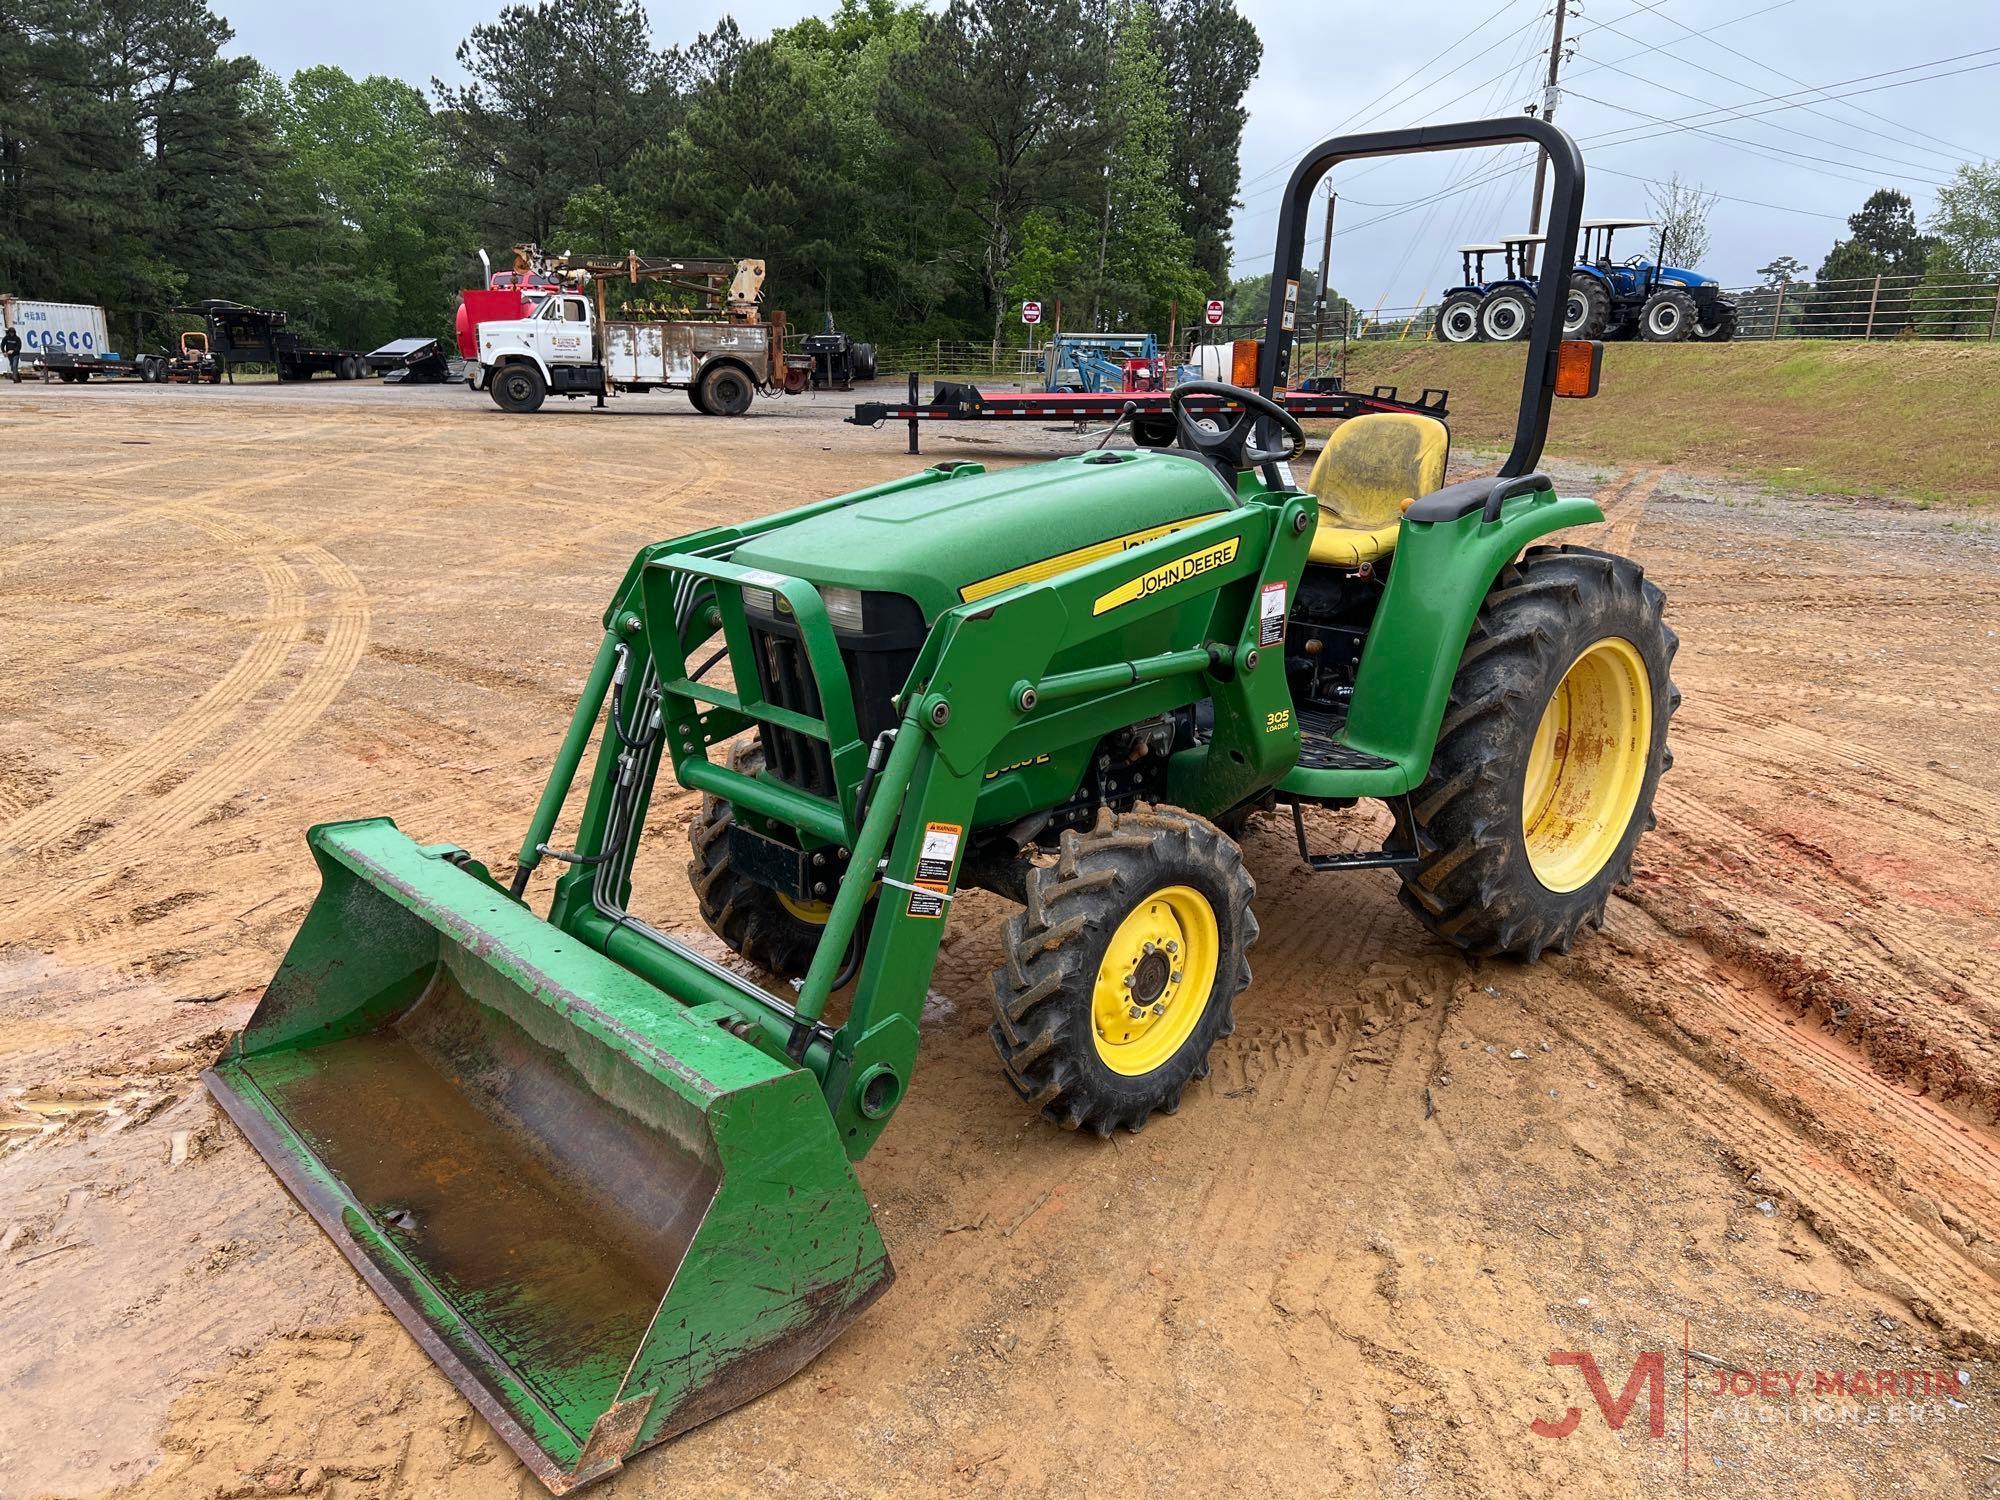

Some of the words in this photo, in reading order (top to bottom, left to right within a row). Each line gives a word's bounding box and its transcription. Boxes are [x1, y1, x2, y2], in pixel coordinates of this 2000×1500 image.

[27, 330, 93, 349] COSCO
[1136, 566, 1180, 597] JOHN
[1182, 545, 1232, 578] DEERE
[1266, 709, 1290, 725] 305
[1265, 721, 1289, 733] LOADER
[936, 824, 958, 833] WARNING
